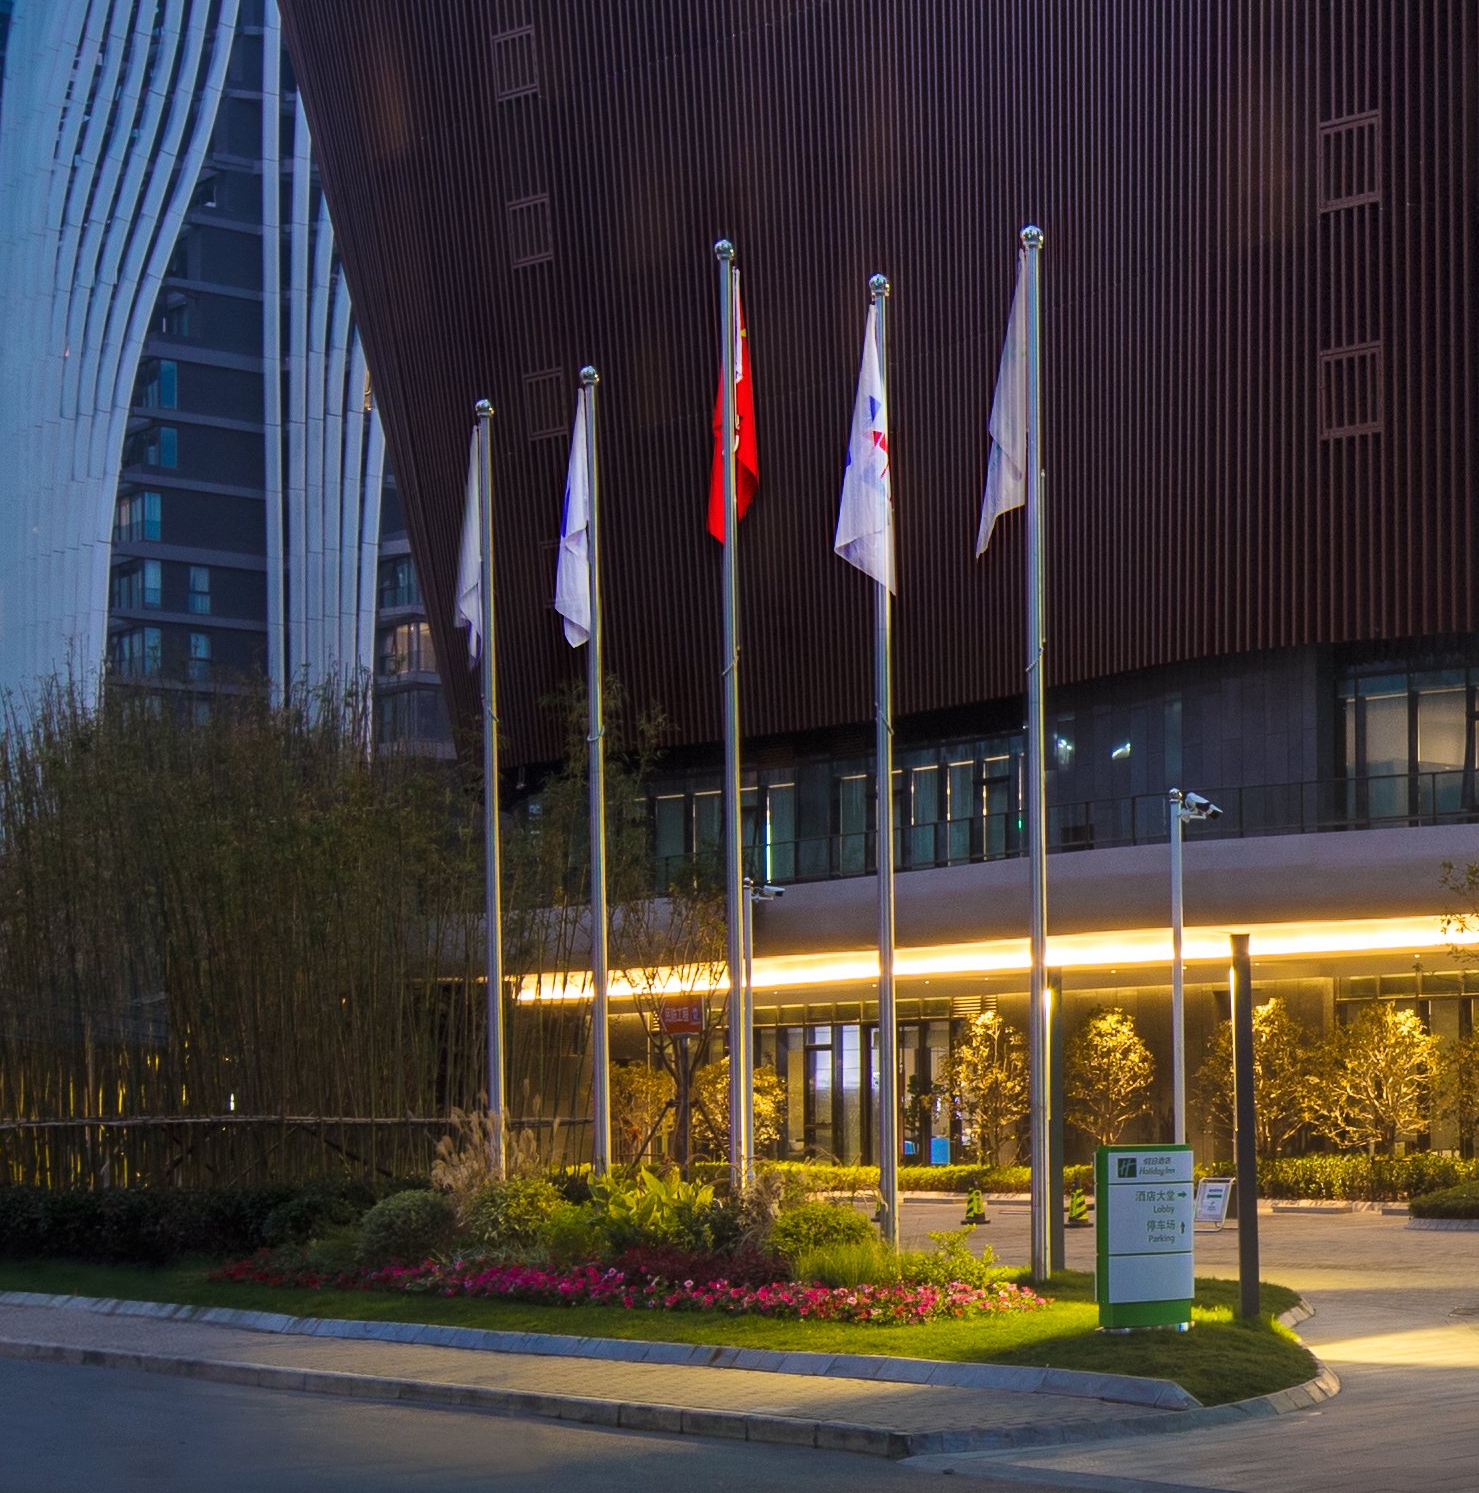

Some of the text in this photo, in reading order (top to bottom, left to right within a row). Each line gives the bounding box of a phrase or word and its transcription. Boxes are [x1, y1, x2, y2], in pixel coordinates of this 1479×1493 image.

[1139, 1167, 1165, 1176] Holiday
[1136, 1190, 1175, 1202] 酒店大堂
[1153, 1205, 1175, 1214] Lobby
[1147, 1219, 1176, 1232] 停车场
[1148, 1234, 1175, 1244] Parking
